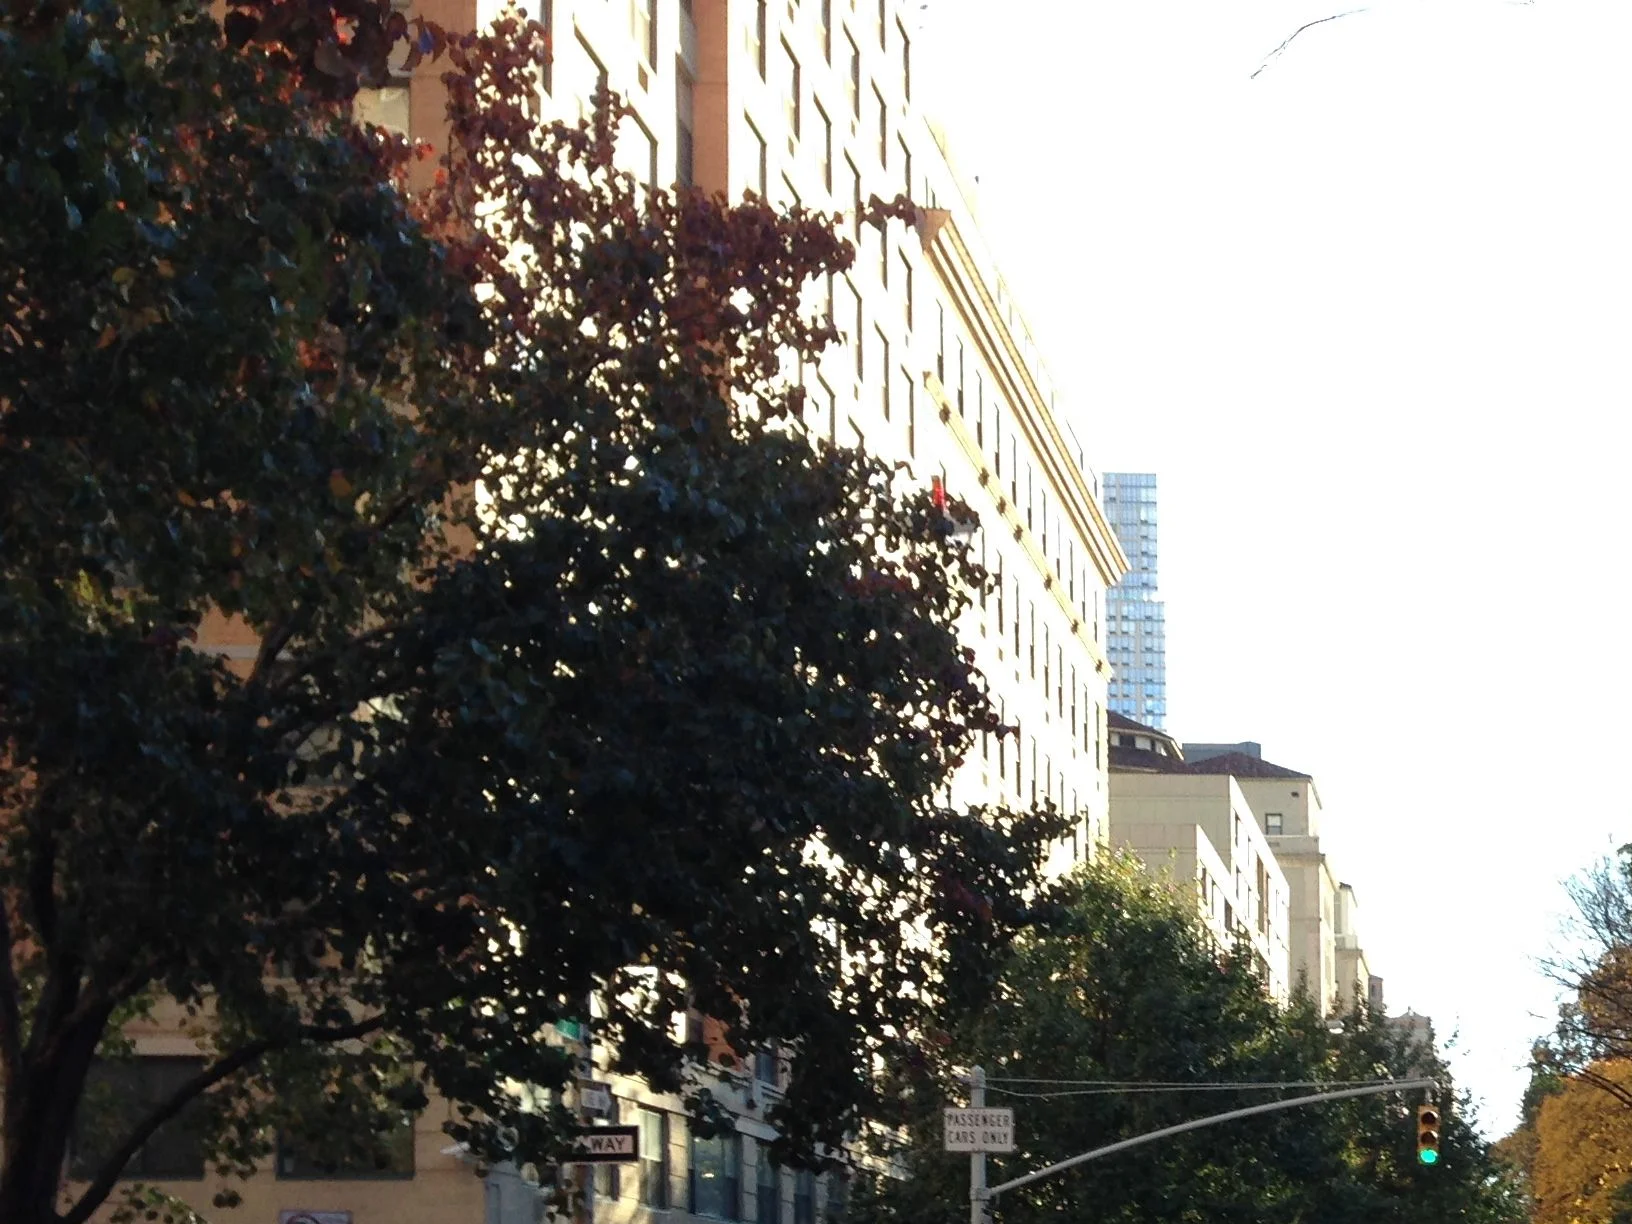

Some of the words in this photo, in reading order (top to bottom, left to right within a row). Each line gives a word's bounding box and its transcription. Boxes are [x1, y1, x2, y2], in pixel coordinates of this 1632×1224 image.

[947, 1113, 1010, 1127] PASSENGER
[591, 1137, 625, 1152] WAY
[947, 1131, 976, 1144] CARS
[983, 1131, 1009, 1144] ONLY
